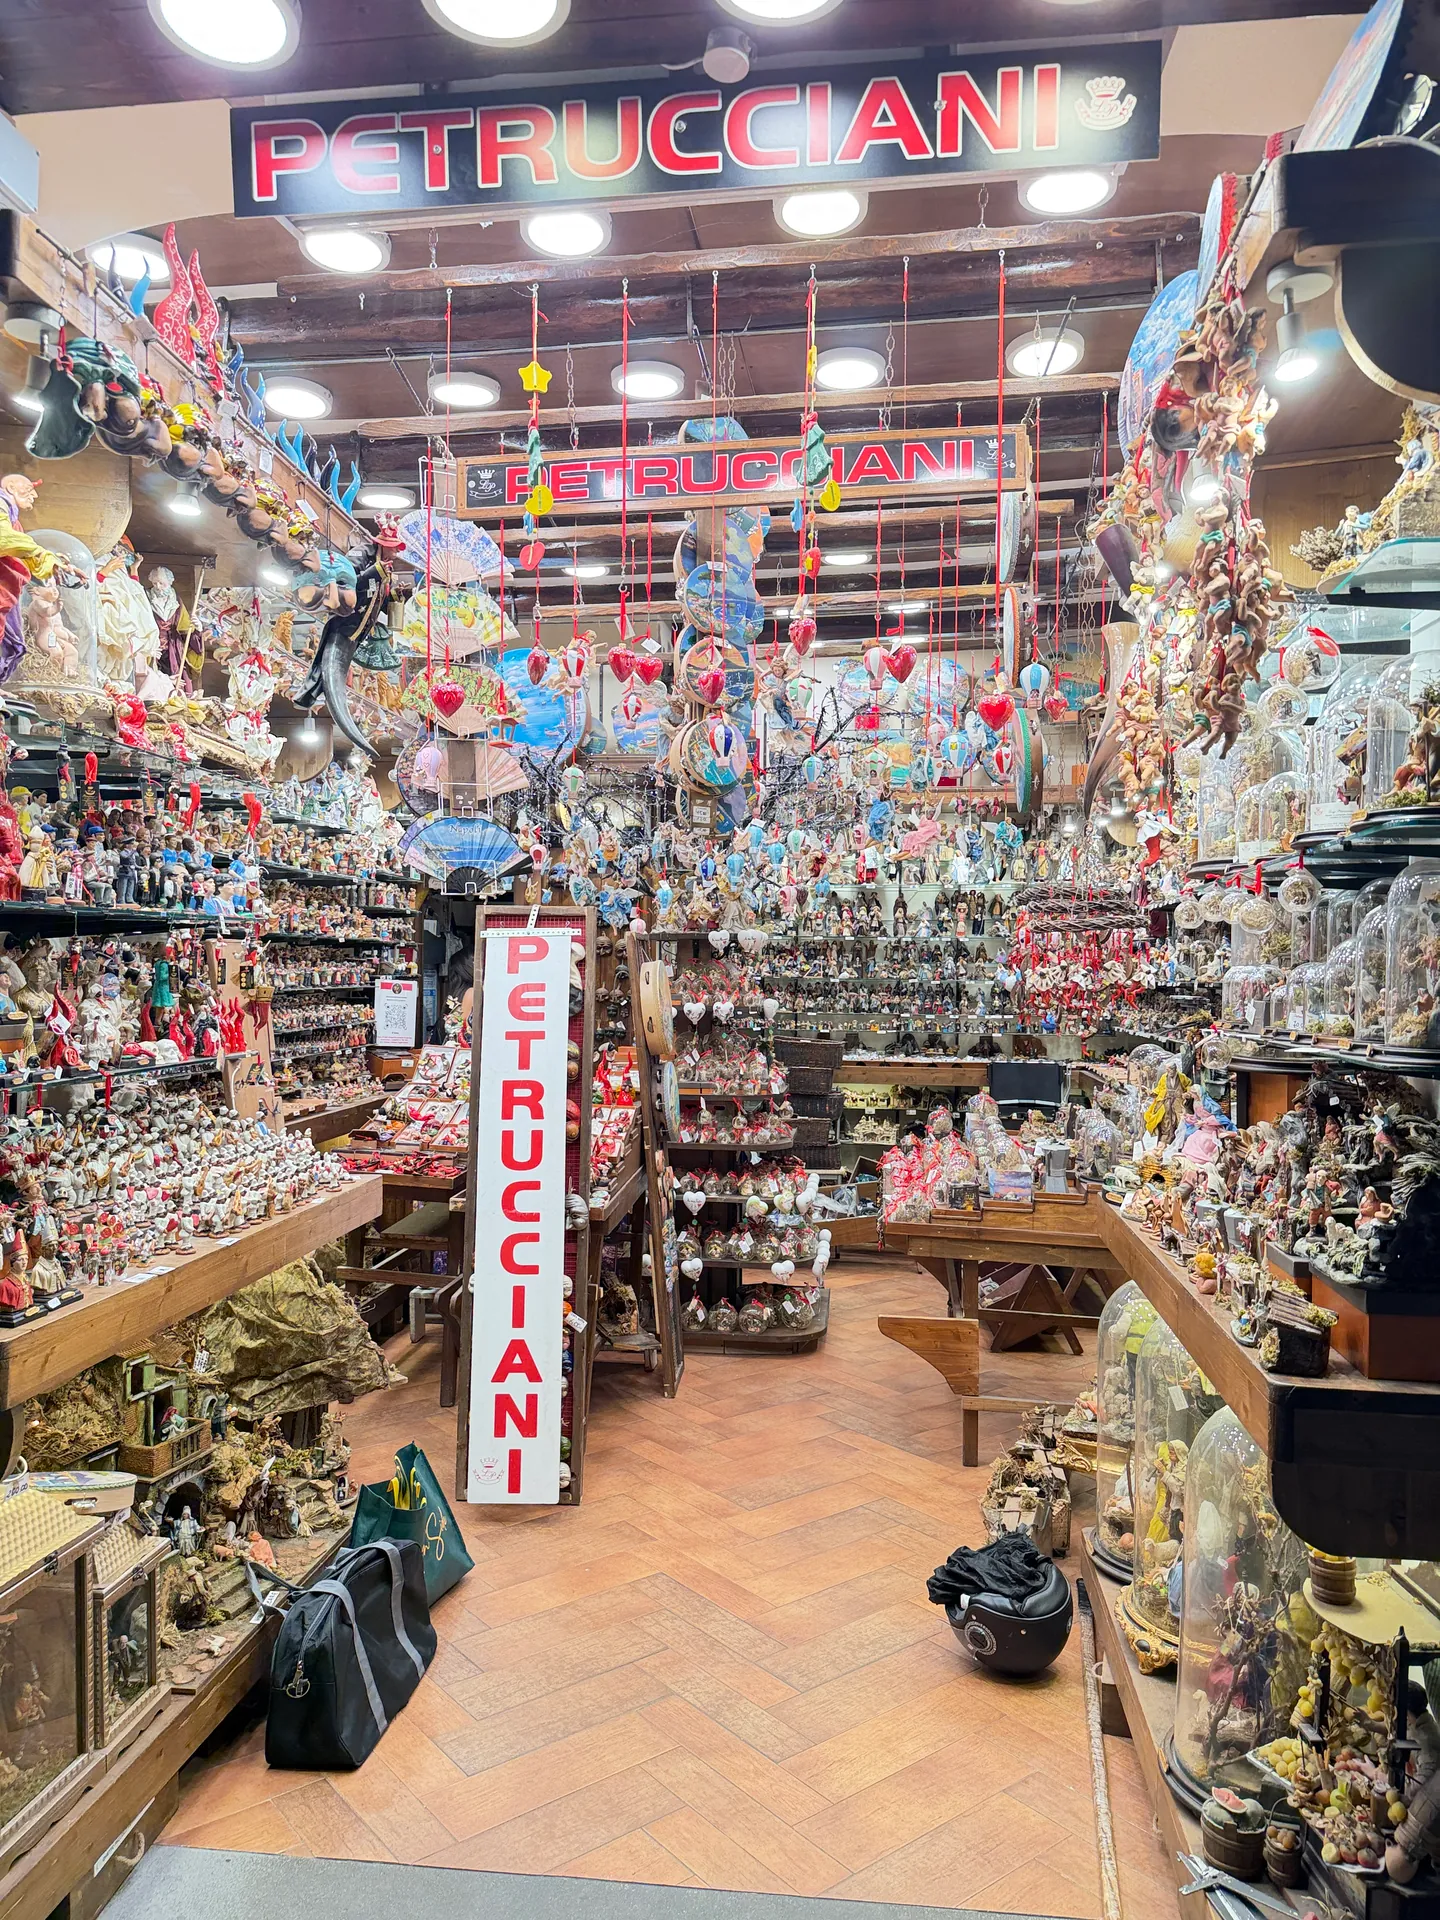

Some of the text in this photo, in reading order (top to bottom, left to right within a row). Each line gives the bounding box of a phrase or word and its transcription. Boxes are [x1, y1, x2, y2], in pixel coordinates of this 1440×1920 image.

[251, 63, 1060, 202] PETRUCCIANI
[449, 822, 481, 836] Napoli
[491, 936, 549, 1494] PETRUCCIANI
